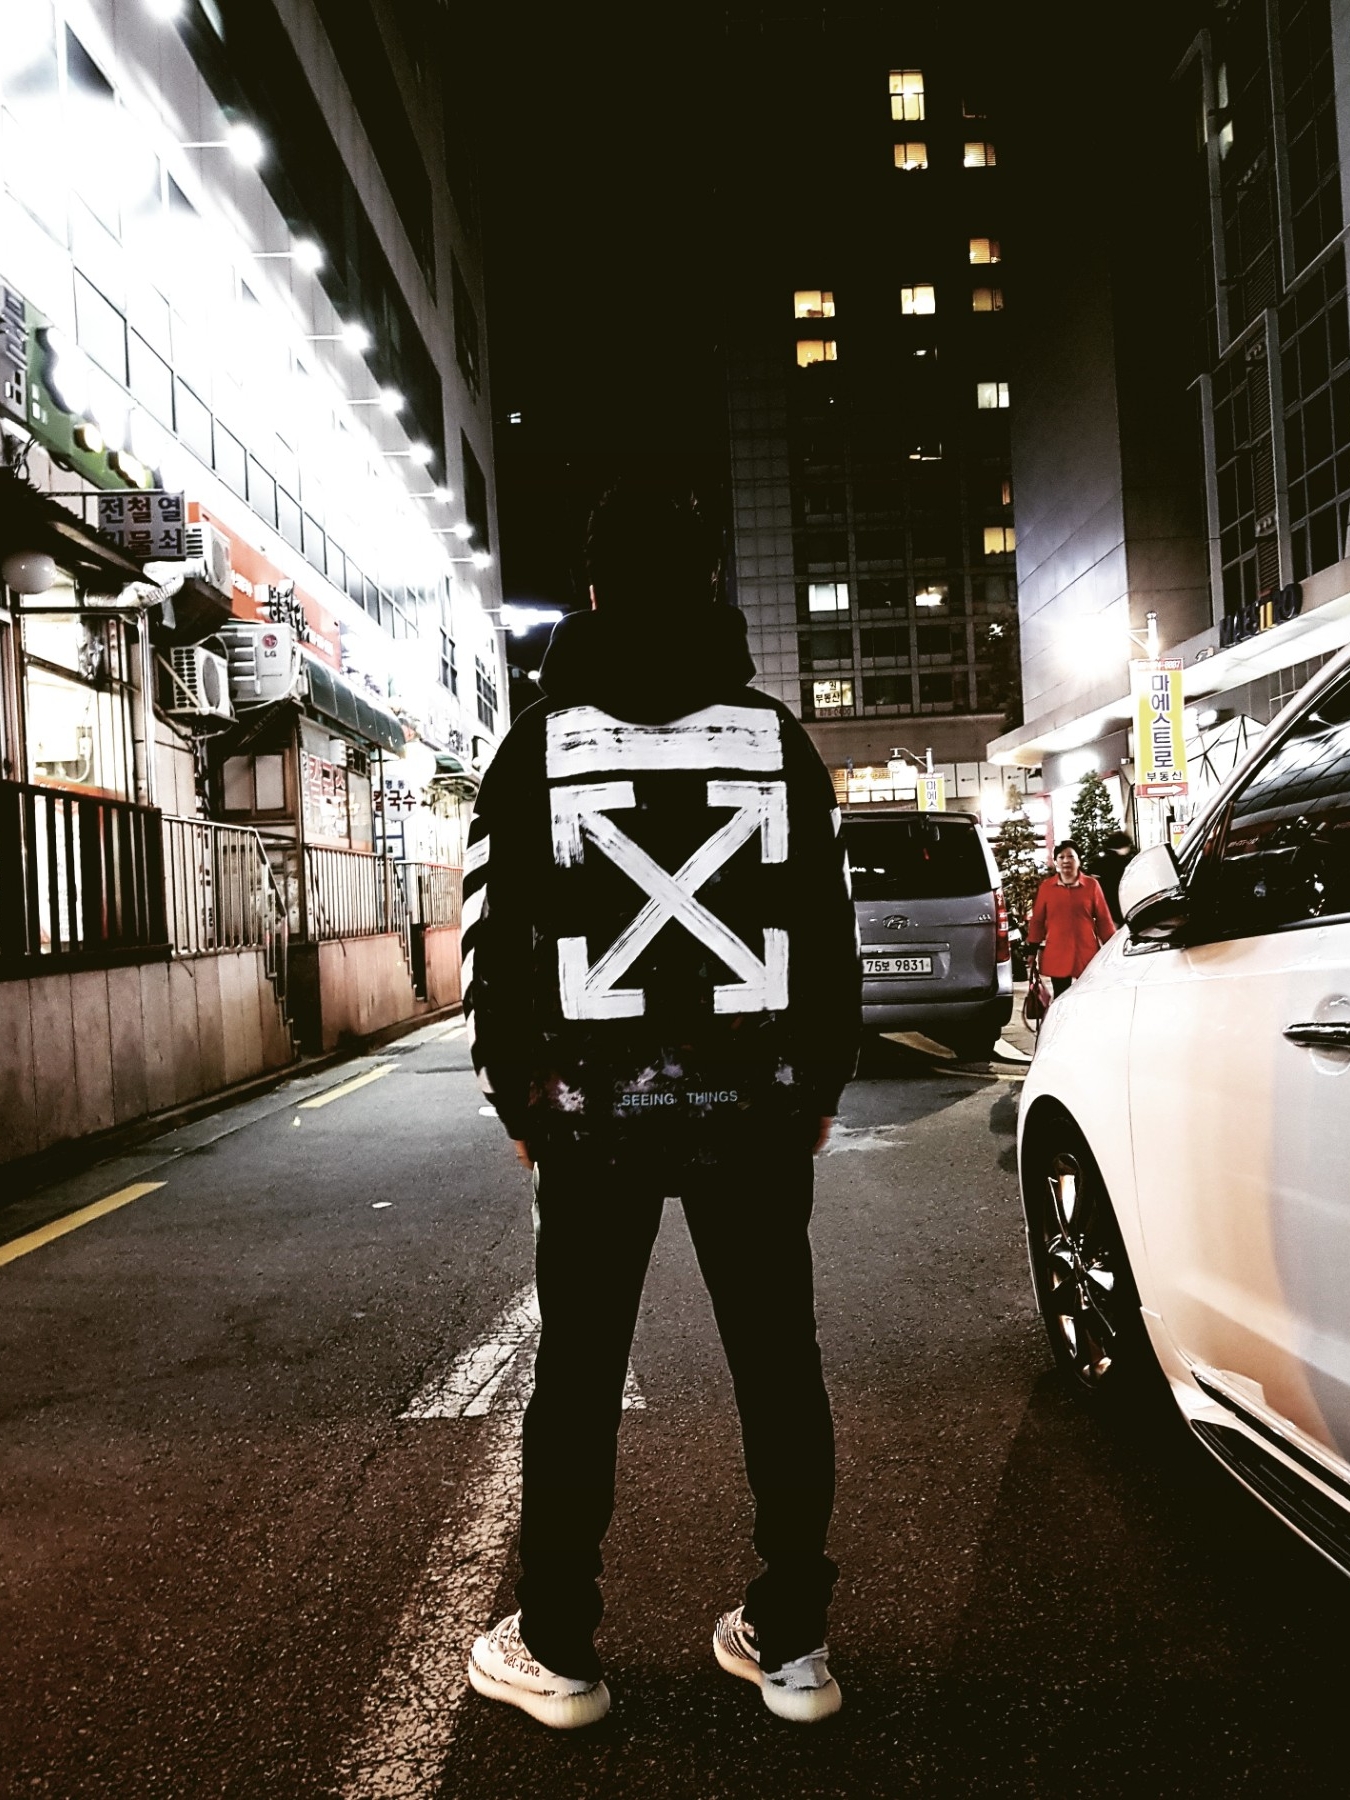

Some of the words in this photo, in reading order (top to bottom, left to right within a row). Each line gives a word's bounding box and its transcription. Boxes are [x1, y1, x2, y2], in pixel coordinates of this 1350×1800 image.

[816, 692, 840, 706] 부동산
[1151, 674, 1174, 768] 마에스트로
[1146, 771, 1183, 782] 부동산
[373, 789, 417, 812] 칼국수
[866, 960, 890, 972] 75보
[895, 959, 925, 971] 9831
[622, 1093, 674, 1106] SEEING
[686, 1090, 738, 1104] THINGS
